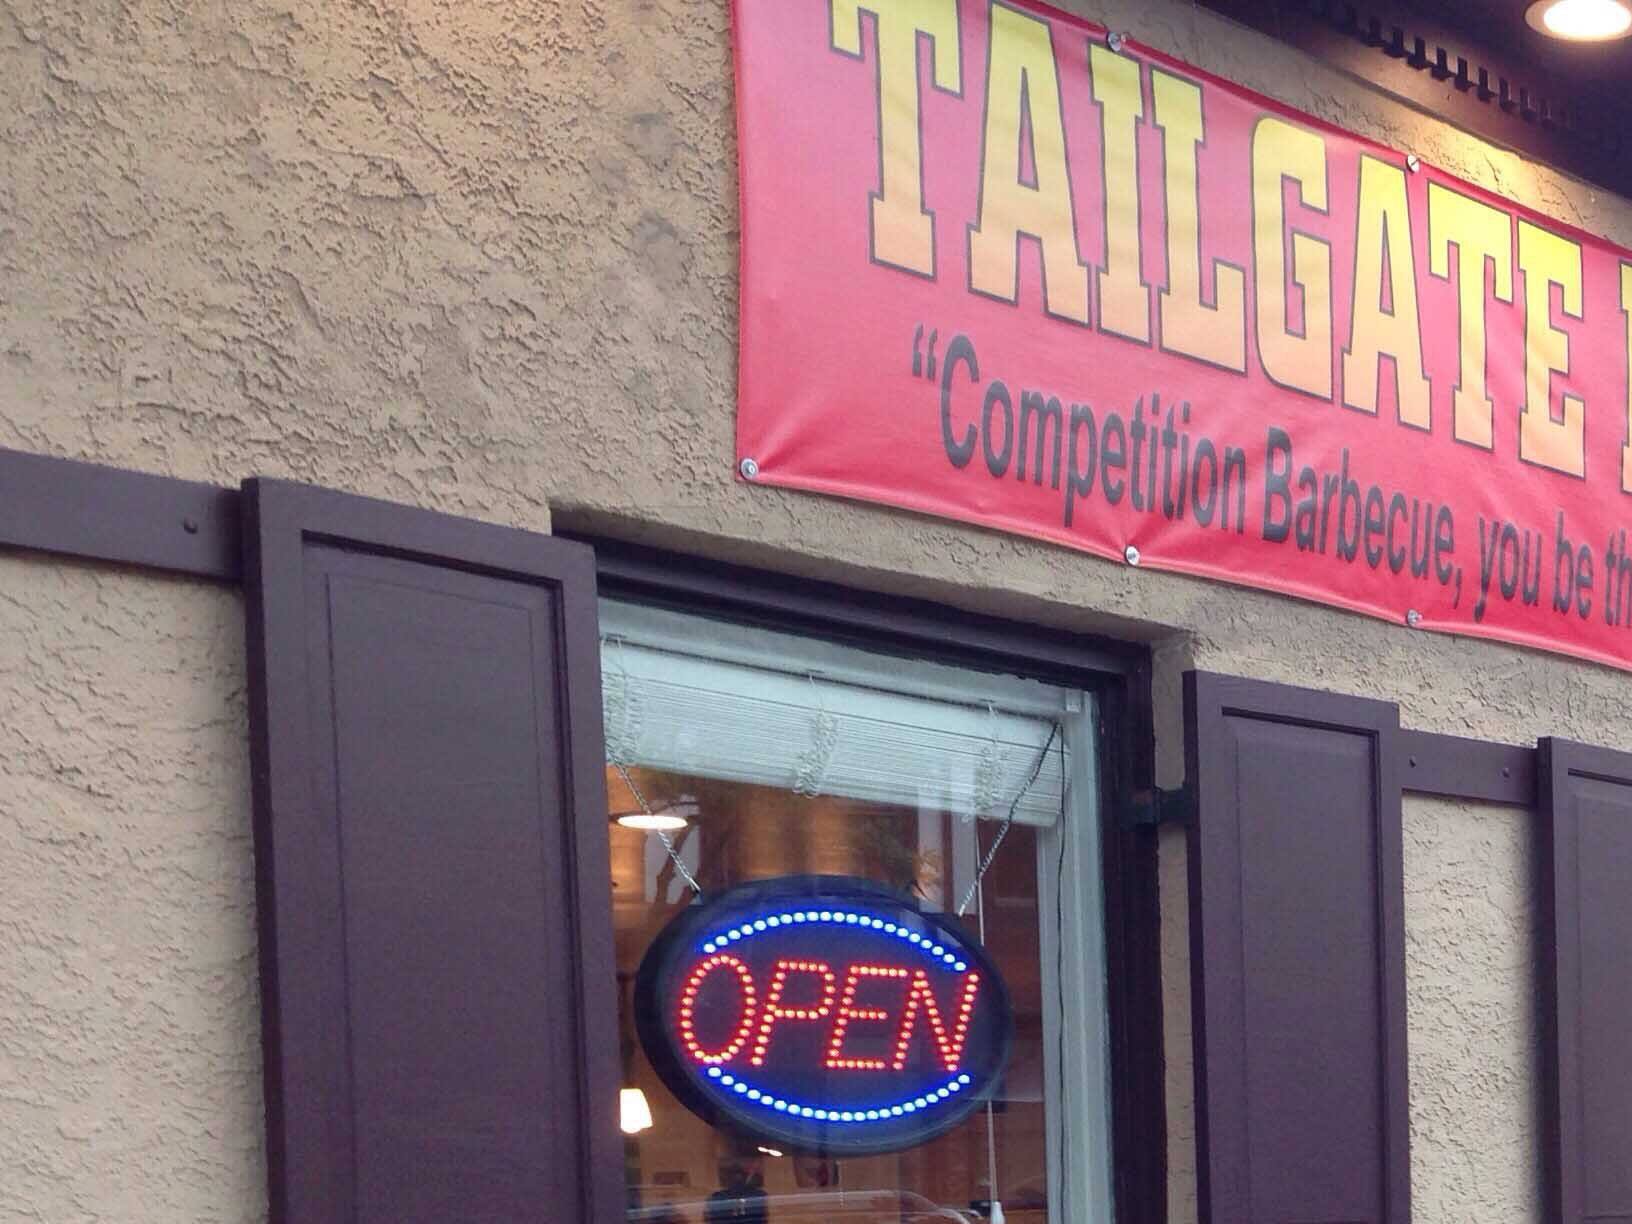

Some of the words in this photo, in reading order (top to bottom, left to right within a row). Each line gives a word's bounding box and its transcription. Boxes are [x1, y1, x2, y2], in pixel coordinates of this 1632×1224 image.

[828, 0, 1588, 481] TAILGATE
[1261, 424, 1463, 610] Barbecue,
[1473, 516, 1542, 624] you
[1553, 510, 1595, 620] be
[678, 953, 980, 1073] OPEN
